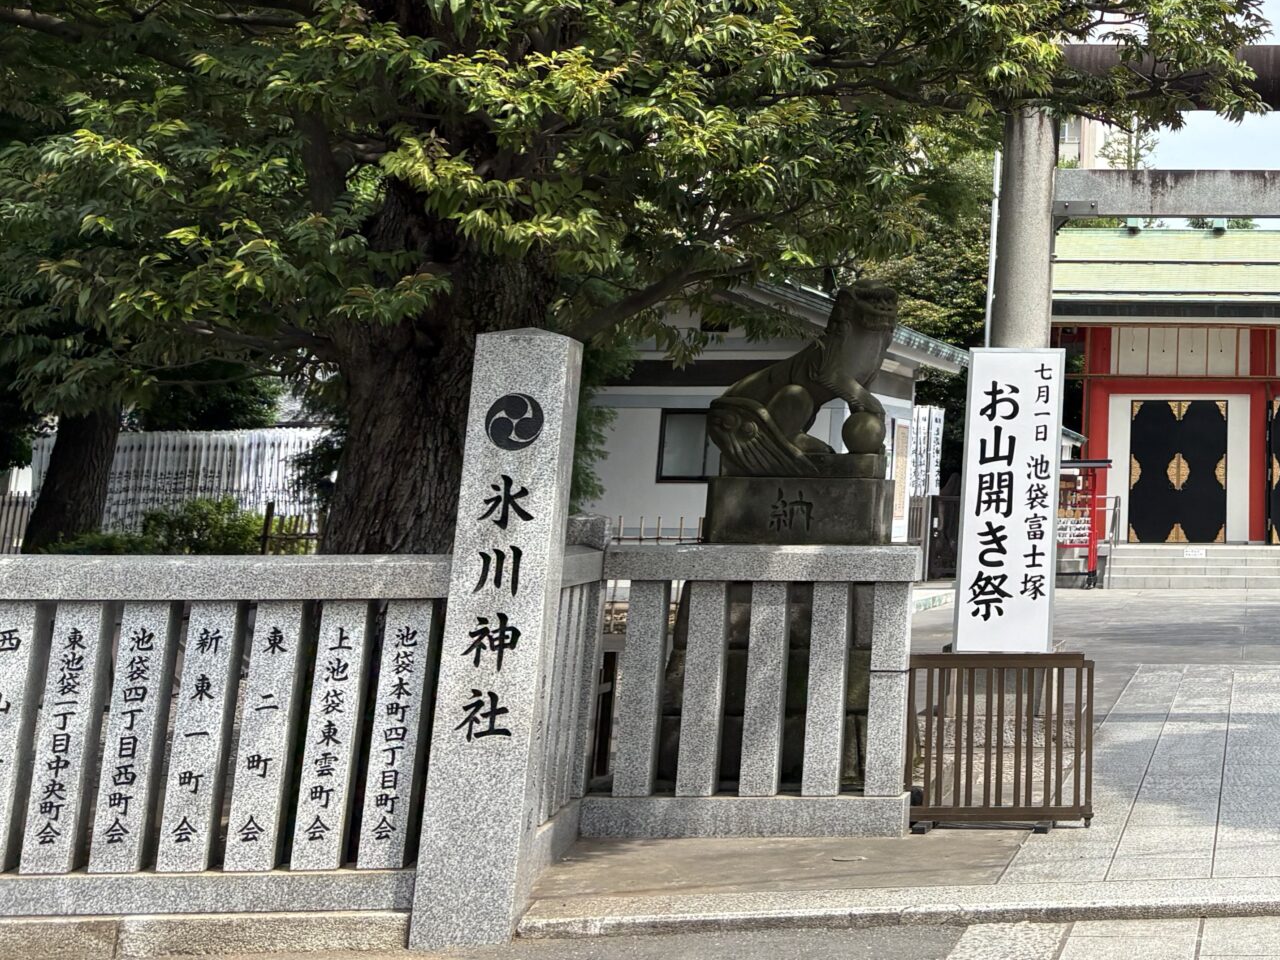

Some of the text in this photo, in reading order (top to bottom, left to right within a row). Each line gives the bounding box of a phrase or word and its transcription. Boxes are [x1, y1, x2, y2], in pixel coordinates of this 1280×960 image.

[966, 380, 1020, 622] お山開き祭
[1019, 363, 1053, 601] 七月一日 池袋富士塚
[454, 474, 534, 743] 氷川神社
[35, 627, 87, 845] 東池袋一丁目中央町会
[103, 627, 154, 844] 池袋四丁目西町会
[171, 627, 223, 843] 新東一町会
[238, 627, 288, 842] 東二町会
[305, 627, 353, 841] 上池袋東雲町会
[372, 626, 418, 840] 池袋本町四丁目町会
